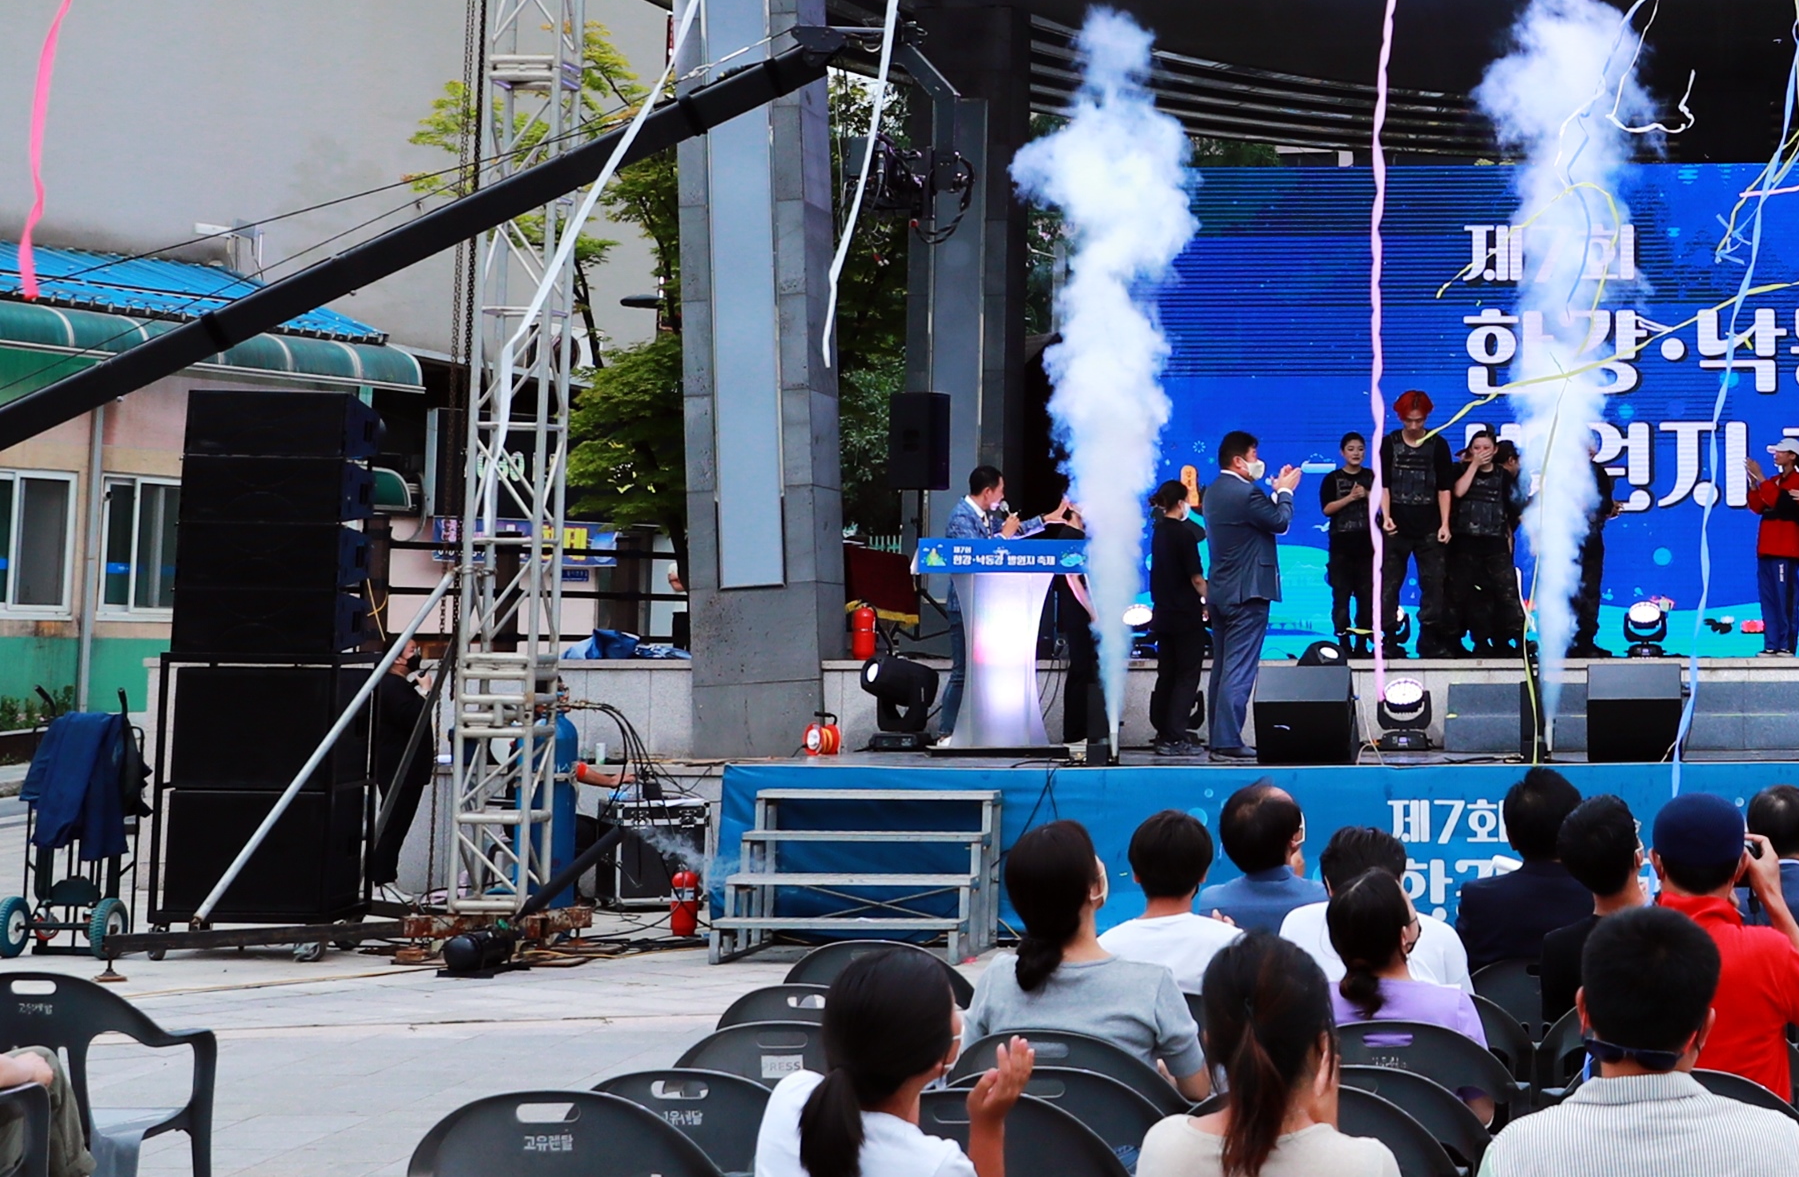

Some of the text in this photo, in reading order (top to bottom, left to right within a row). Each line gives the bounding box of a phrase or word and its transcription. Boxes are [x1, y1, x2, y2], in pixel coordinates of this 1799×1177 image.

[1463, 224, 1635, 283] 제7회
[1387, 799, 1509, 844] 제7회
[524, 1134, 573, 1151] 고유렌탈
